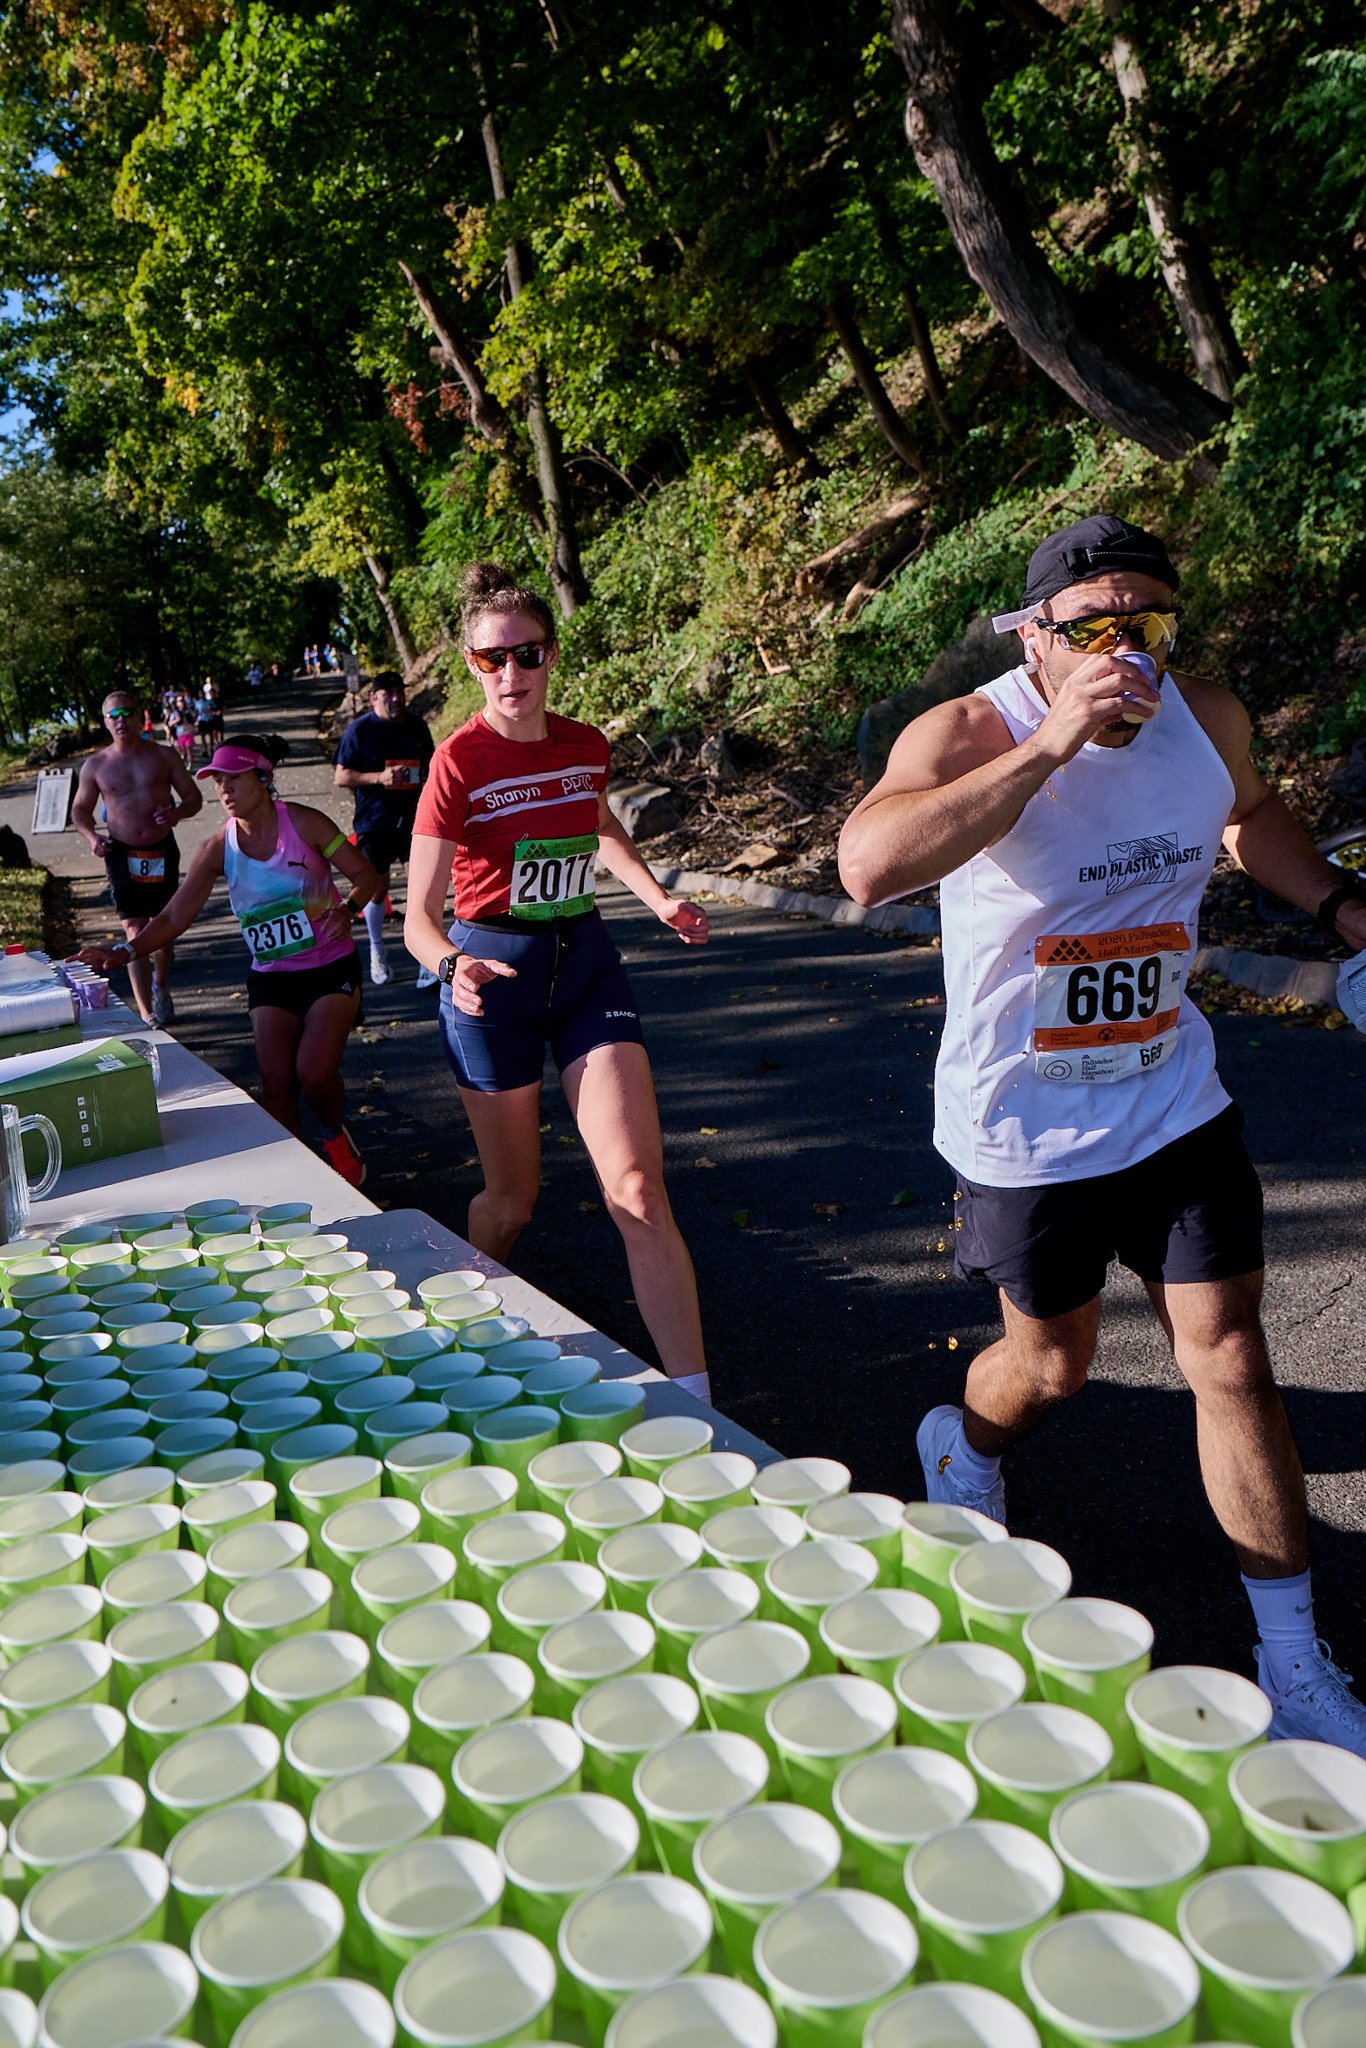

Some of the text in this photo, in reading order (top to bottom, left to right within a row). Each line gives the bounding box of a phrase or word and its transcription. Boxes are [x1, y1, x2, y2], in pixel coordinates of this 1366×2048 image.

[485, 786, 541, 809] Shanyn
[140, 860, 149, 876] 8
[1079, 846, 1203, 882] END PLASTIC WASTE
[248, 914, 304, 952] 2376
[1129, 928, 1171, 942] Palisades
[1098, 942, 1173, 958] Half Marathon
[1066, 957, 1161, 1025] 669
